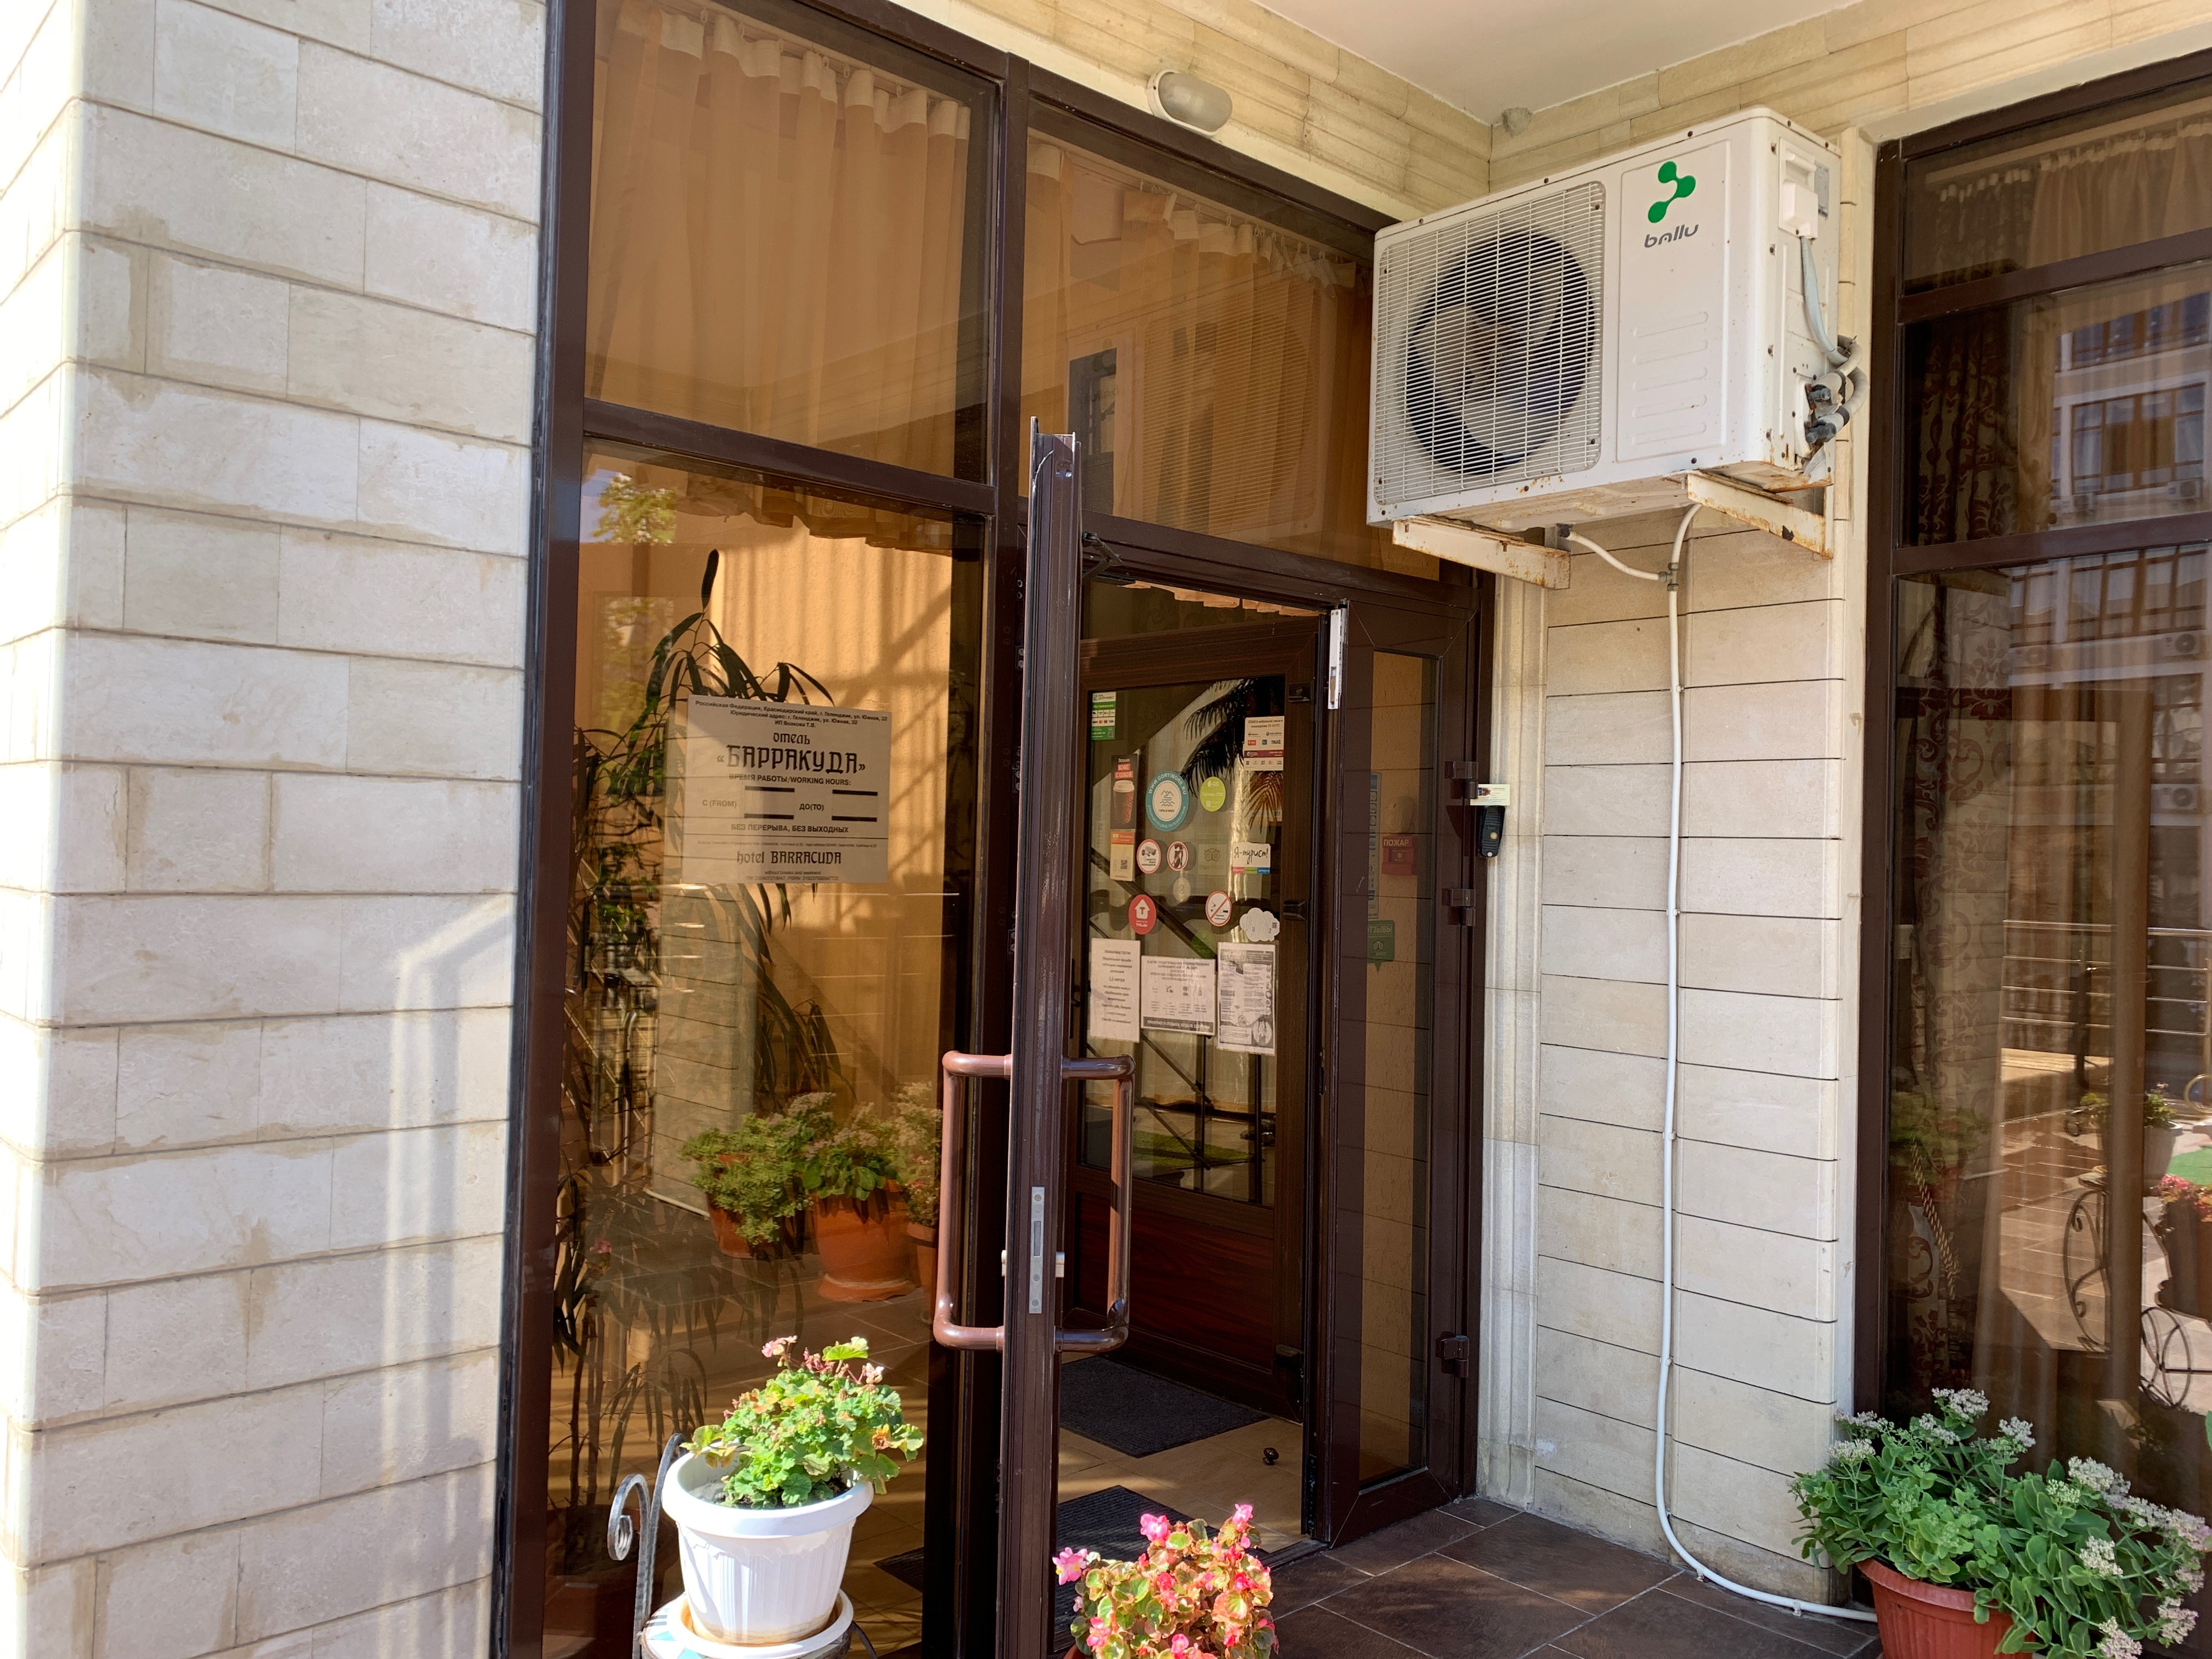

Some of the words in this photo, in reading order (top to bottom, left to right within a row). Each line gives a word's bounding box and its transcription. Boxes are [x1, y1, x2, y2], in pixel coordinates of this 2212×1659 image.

[1644, 224, 1699, 248] ballu
[730, 709, 768, 718] Юридический
[763, 706, 804, 714] Краснодарский
[773, 732, 810, 746] отель
[716, 744, 865, 774] «БАРРАКУДА»
[757, 775, 824, 785] РАБОТЫ/WORKING
[709, 799, 737, 808] (FROM)
[748, 824, 790, 833] ПЕРЕРЫВА,
[807, 826, 849, 834] ВЫХОДНЫХ
[1383, 839, 1409, 847] ПОЖАР
[737, 851, 764, 865] hotel
[771, 851, 842, 865] BARRACUDA
[1234, 847, 1268, 865] Я-турист!
[1368, 925, 1392, 933] ТЗЫВЫ
